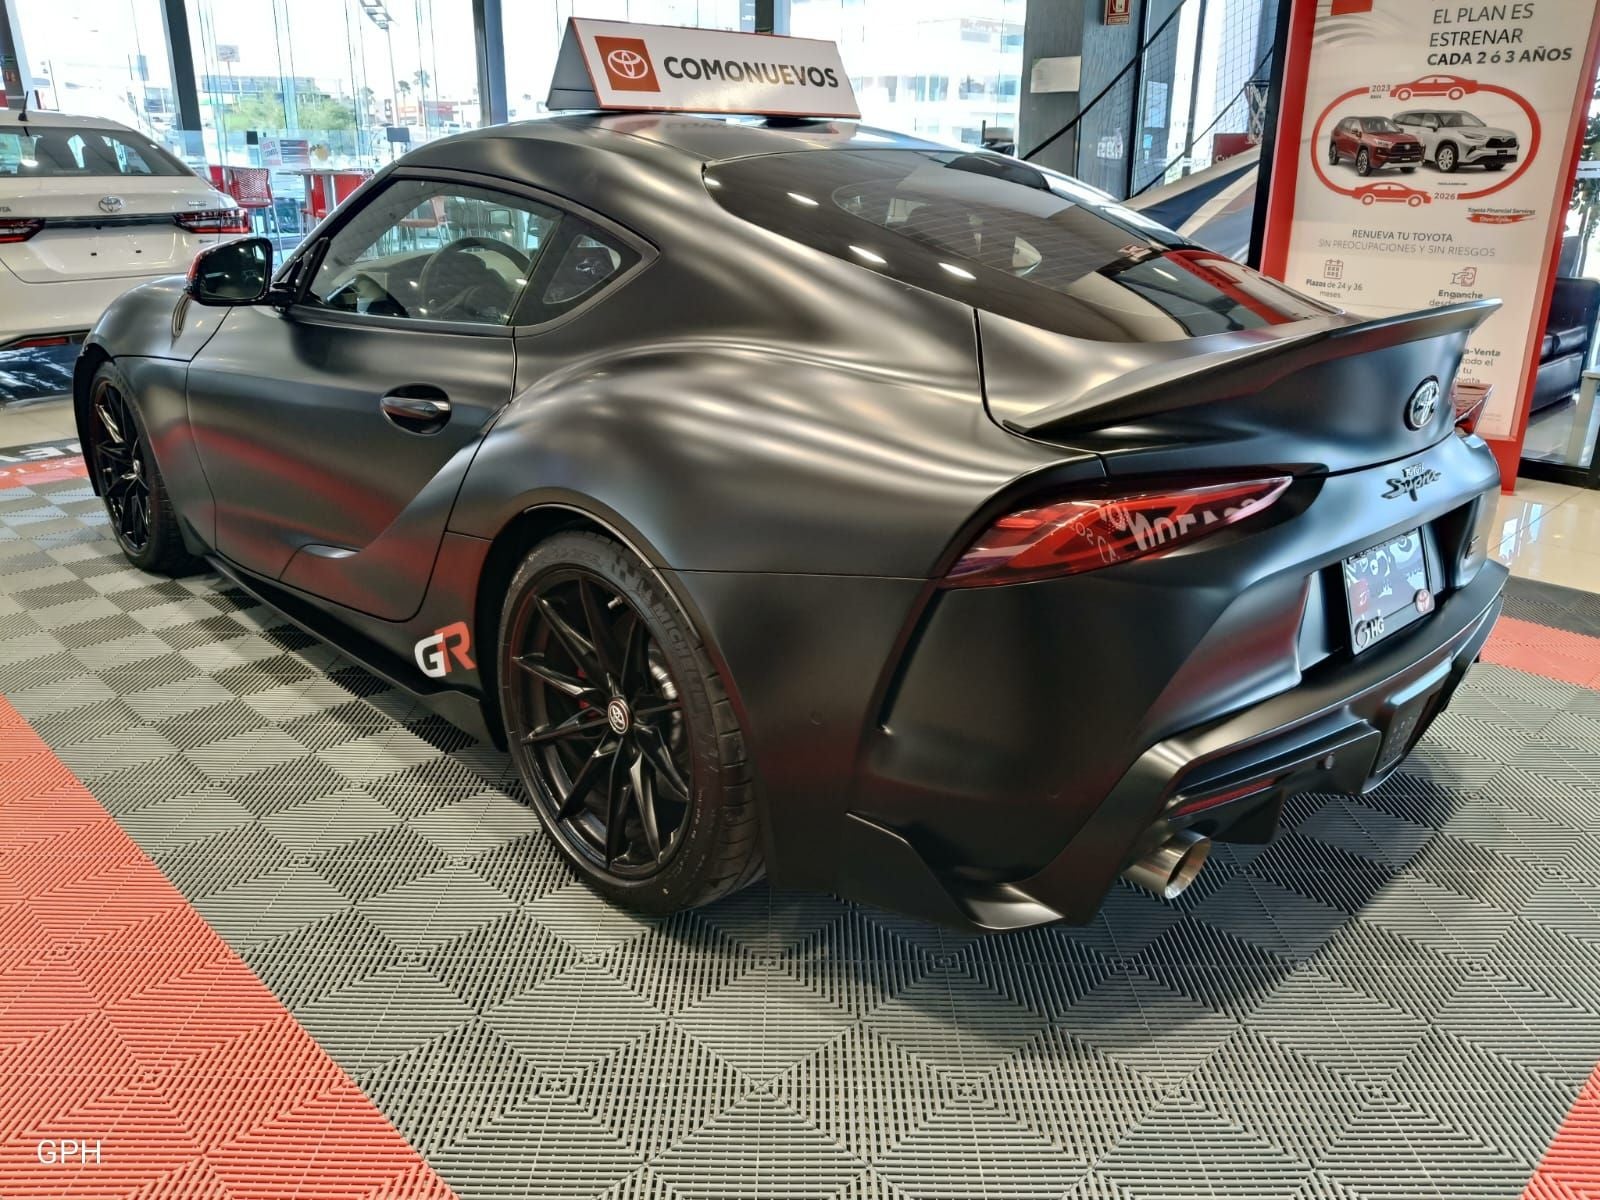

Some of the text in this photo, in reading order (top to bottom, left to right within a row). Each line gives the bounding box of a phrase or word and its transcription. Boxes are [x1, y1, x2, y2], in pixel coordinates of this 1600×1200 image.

[1433, 3, 1535, 24] EL PLAN ES
[1429, 28, 1524, 47] ESTRENAR
[1427, 46, 1573, 66] CADA 2 ó 3 AÑOS
[663, 55, 839, 88] COMONUEVOS
[1371, 84, 1391, 92] 2023
[1434, 192, 1456, 200] 2026
[1352, 229, 1454, 242] RENUEVA TU TOYOTA
[1319, 238, 1496, 257] SIN PREOCUPACIONES Y SIN RIESGOS
[1306, 278, 1326, 288] Plazos
[1337, 281, 1346, 289] 24
[1438, 289, 1483, 299] Enganche
[1463, 347, 1501, 357] a-Venta
[1484, 359, 1494, 367] el
[414, 620, 477, 678] GR
